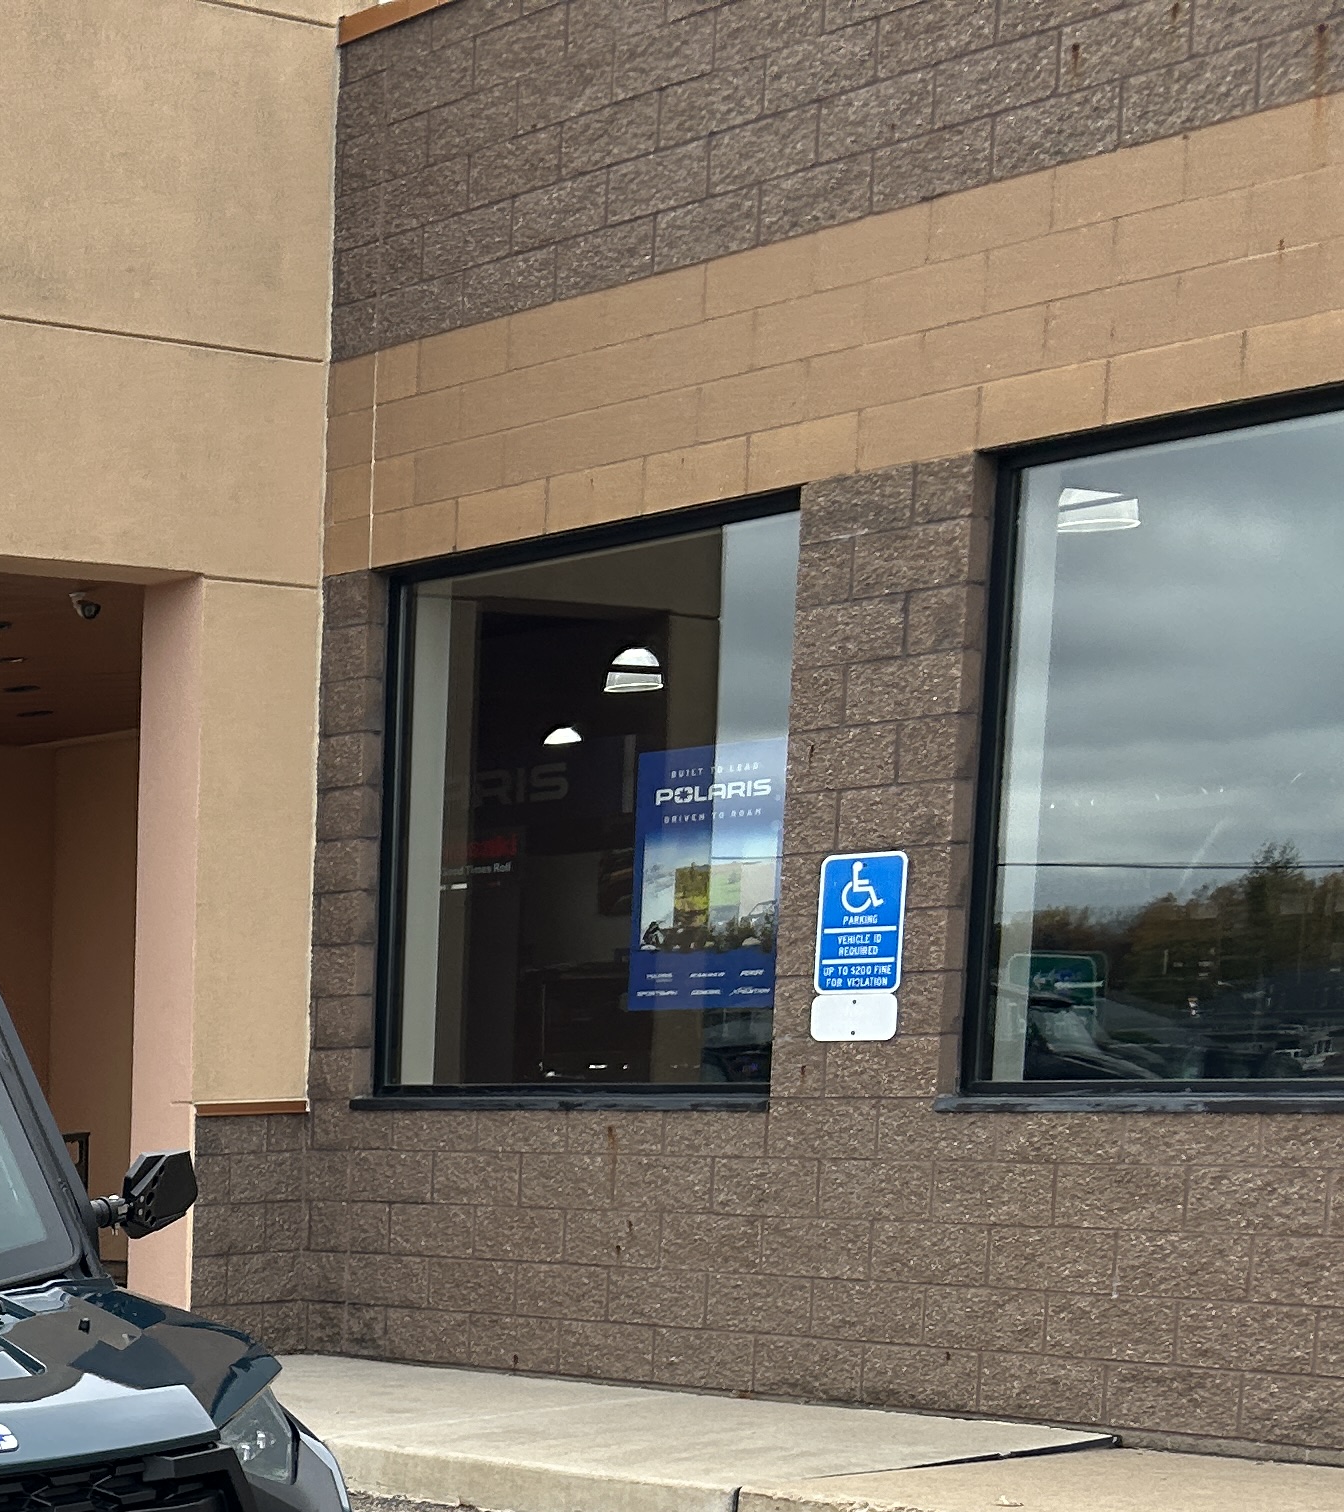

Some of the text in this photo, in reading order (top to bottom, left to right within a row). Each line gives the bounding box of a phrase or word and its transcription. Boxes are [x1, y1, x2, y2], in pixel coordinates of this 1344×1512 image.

[671, 767, 704, 779] BUILT
[729, 762, 760, 772] LEAD
[655, 778, 772, 806] POLARIS
[664, 808, 762, 824] DRIVEN TO ROAM
[843, 914, 878, 925] PARKING
[837, 934, 871, 945] VEHICLE
[838, 946, 879, 956] REQUIRED
[823, 966, 835, 977] UP
[838, 966, 849, 976] TO
[850, 965, 872, 976] $200
[826, 976, 888, 988] FOR VIOLATION
